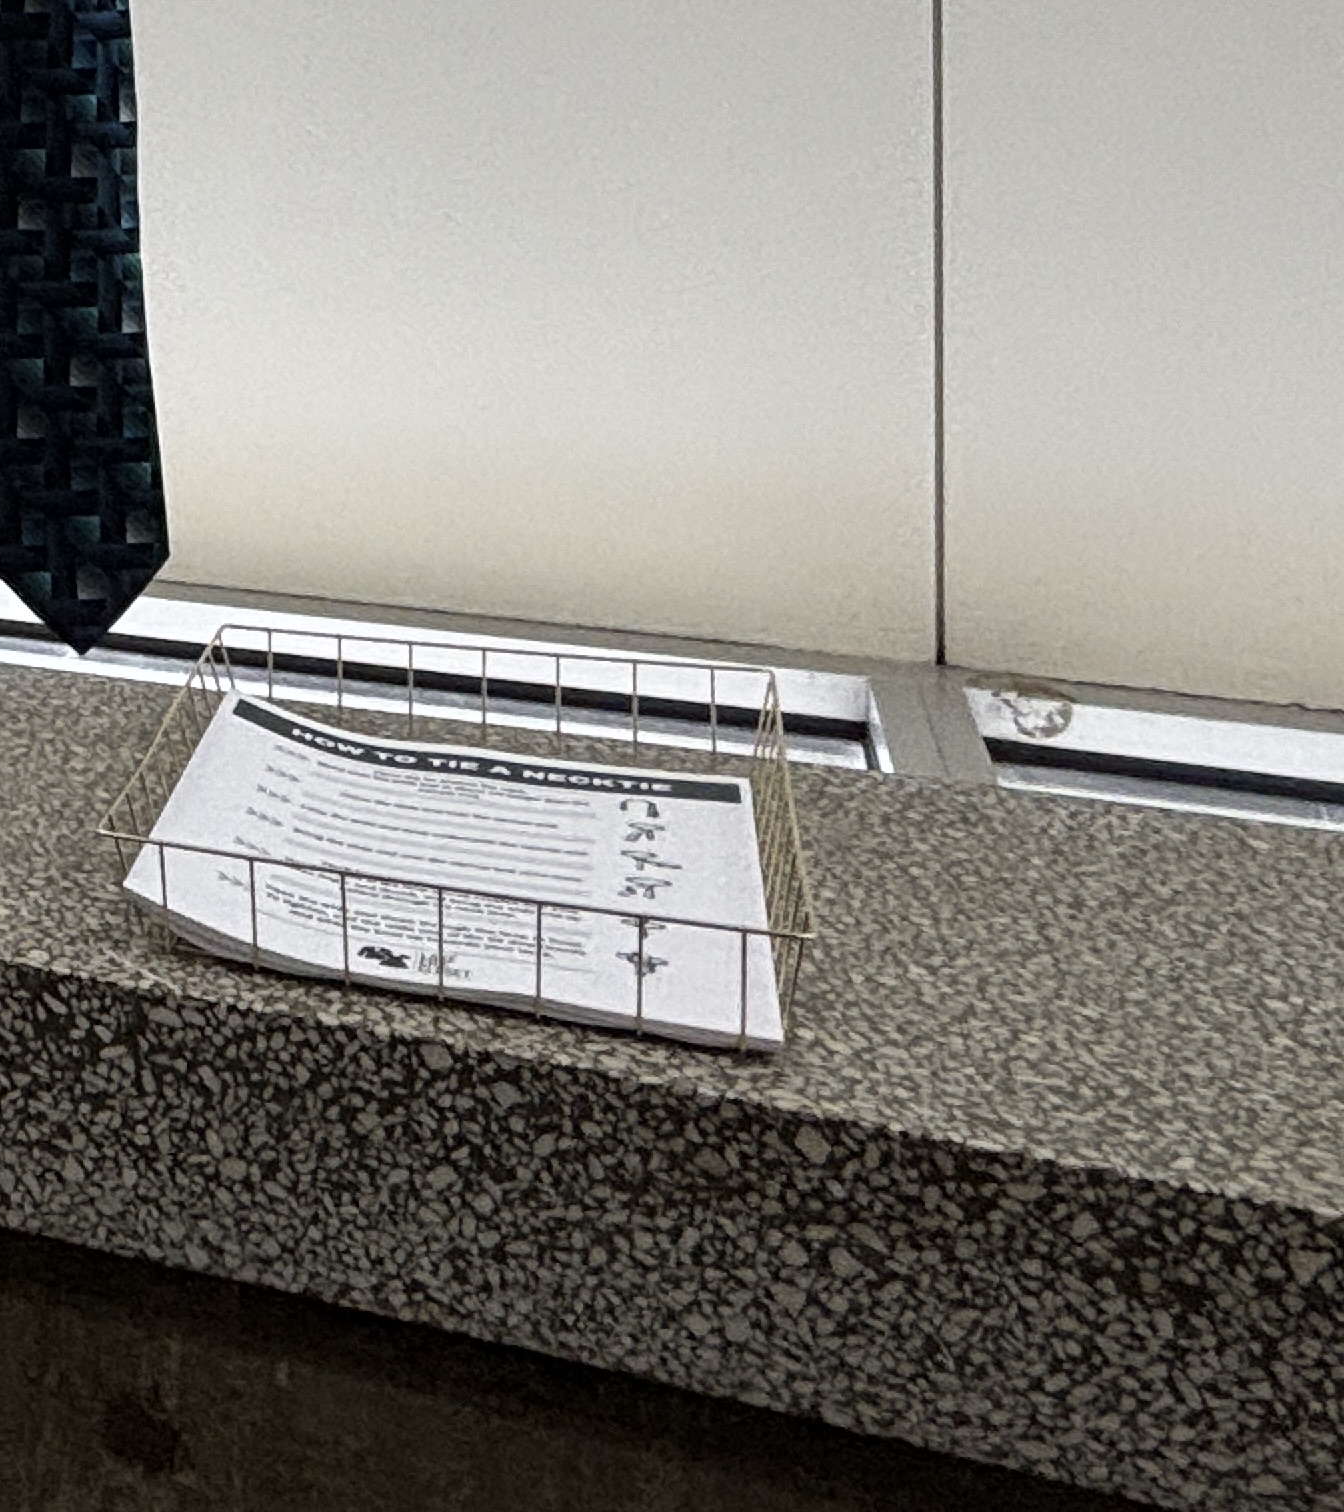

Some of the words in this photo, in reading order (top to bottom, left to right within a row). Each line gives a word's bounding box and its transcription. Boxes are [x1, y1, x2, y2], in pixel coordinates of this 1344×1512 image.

[290, 727, 365, 757] HOW
[375, 749, 418, 764] TO
[427, 757, 481, 771] TIE
[488, 765, 512, 777] A
[521, 769, 673, 792] NECKTIE
